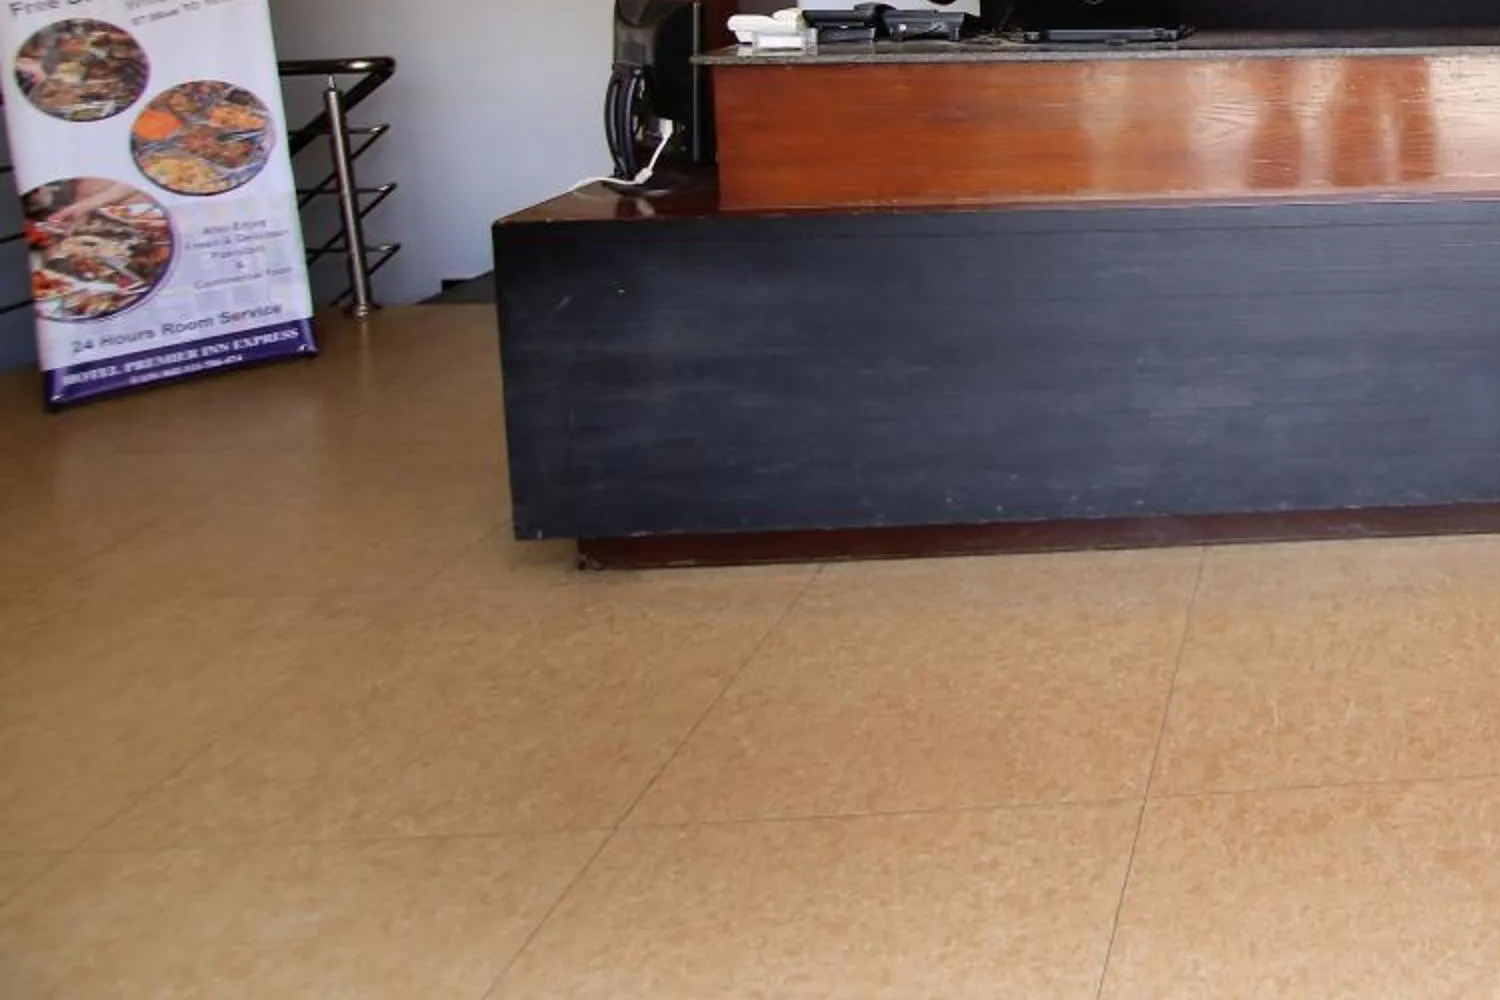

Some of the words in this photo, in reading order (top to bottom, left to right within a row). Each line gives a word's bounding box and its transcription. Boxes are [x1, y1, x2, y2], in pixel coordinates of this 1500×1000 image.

[8, 0, 60, 17] Free
[70, 340, 94, 355] 24
[99, 329, 155, 347] Hours
[162, 317, 214, 336] Room
[218, 304, 283, 325] Service
[64, 365, 120, 386] HOTEL
[124, 350, 199, 374] PREMIER
[201, 343, 230, 358] INN
[233, 327, 299, 351] EXPRESS
